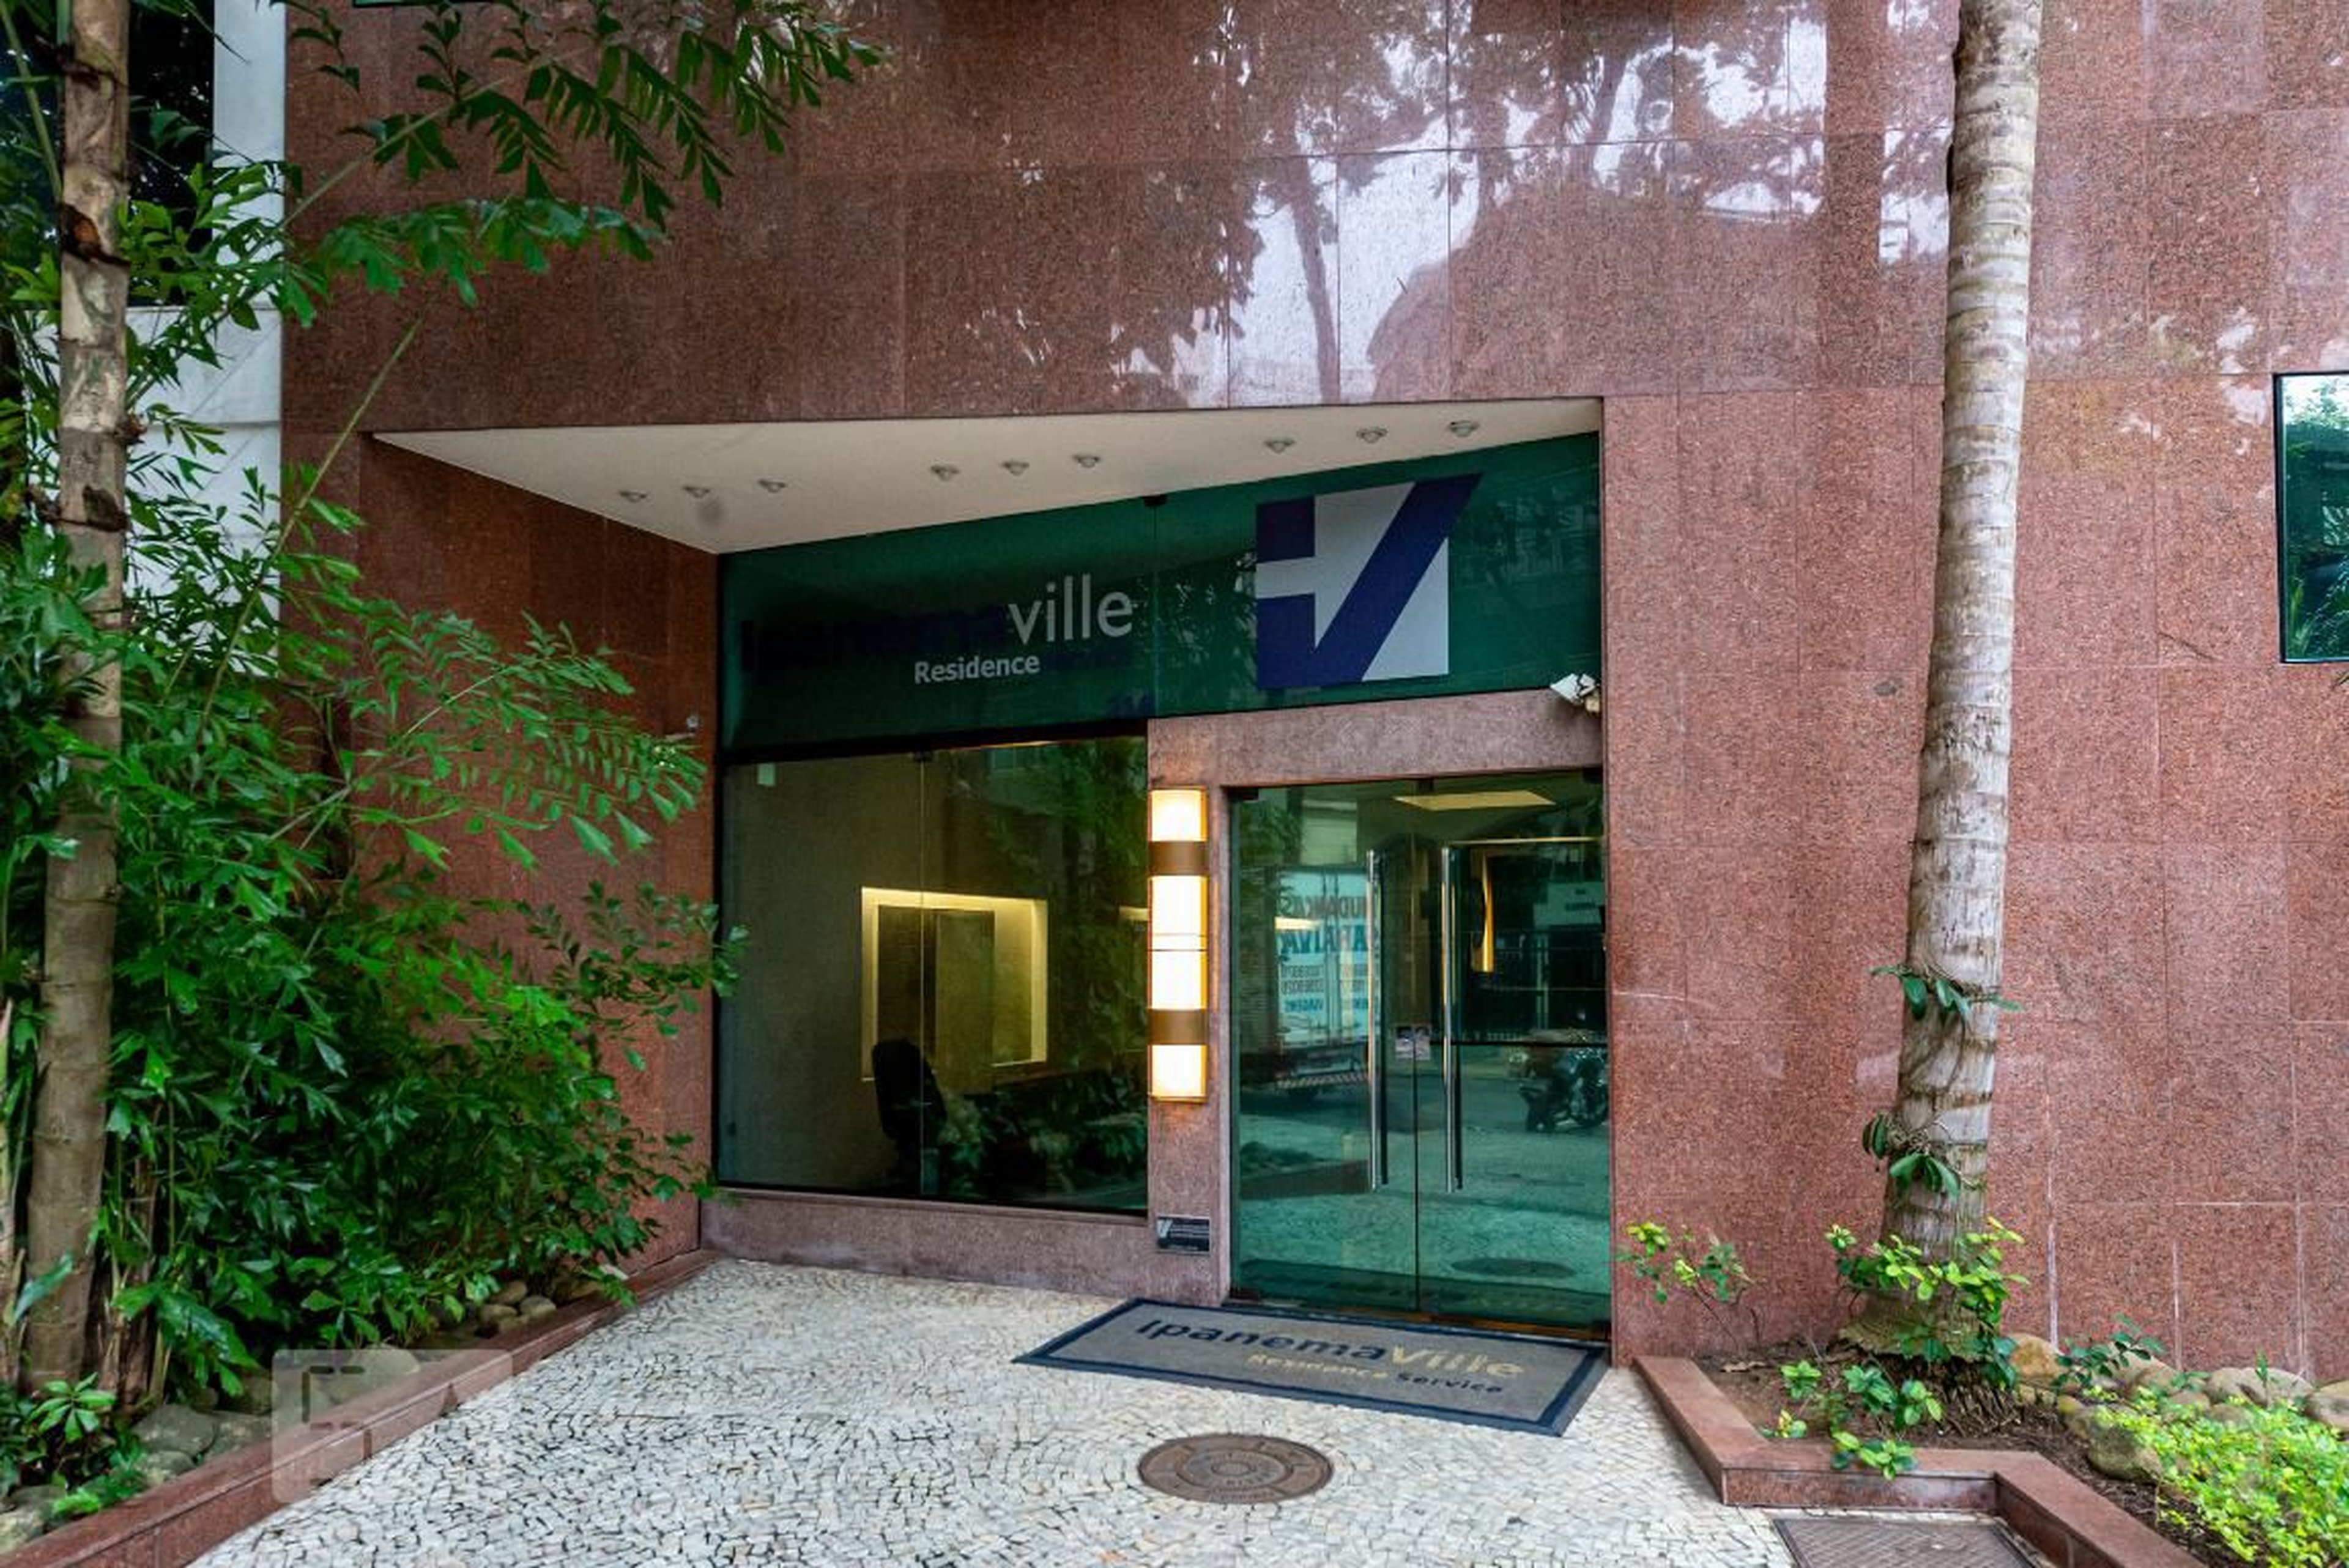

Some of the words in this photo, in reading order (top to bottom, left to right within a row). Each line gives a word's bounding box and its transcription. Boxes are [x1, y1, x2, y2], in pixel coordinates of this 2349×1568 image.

[1008, 574, 1133, 645] ville
[915, 655, 1040, 684] Residence
[1398, 1374, 1502, 1393] Service
